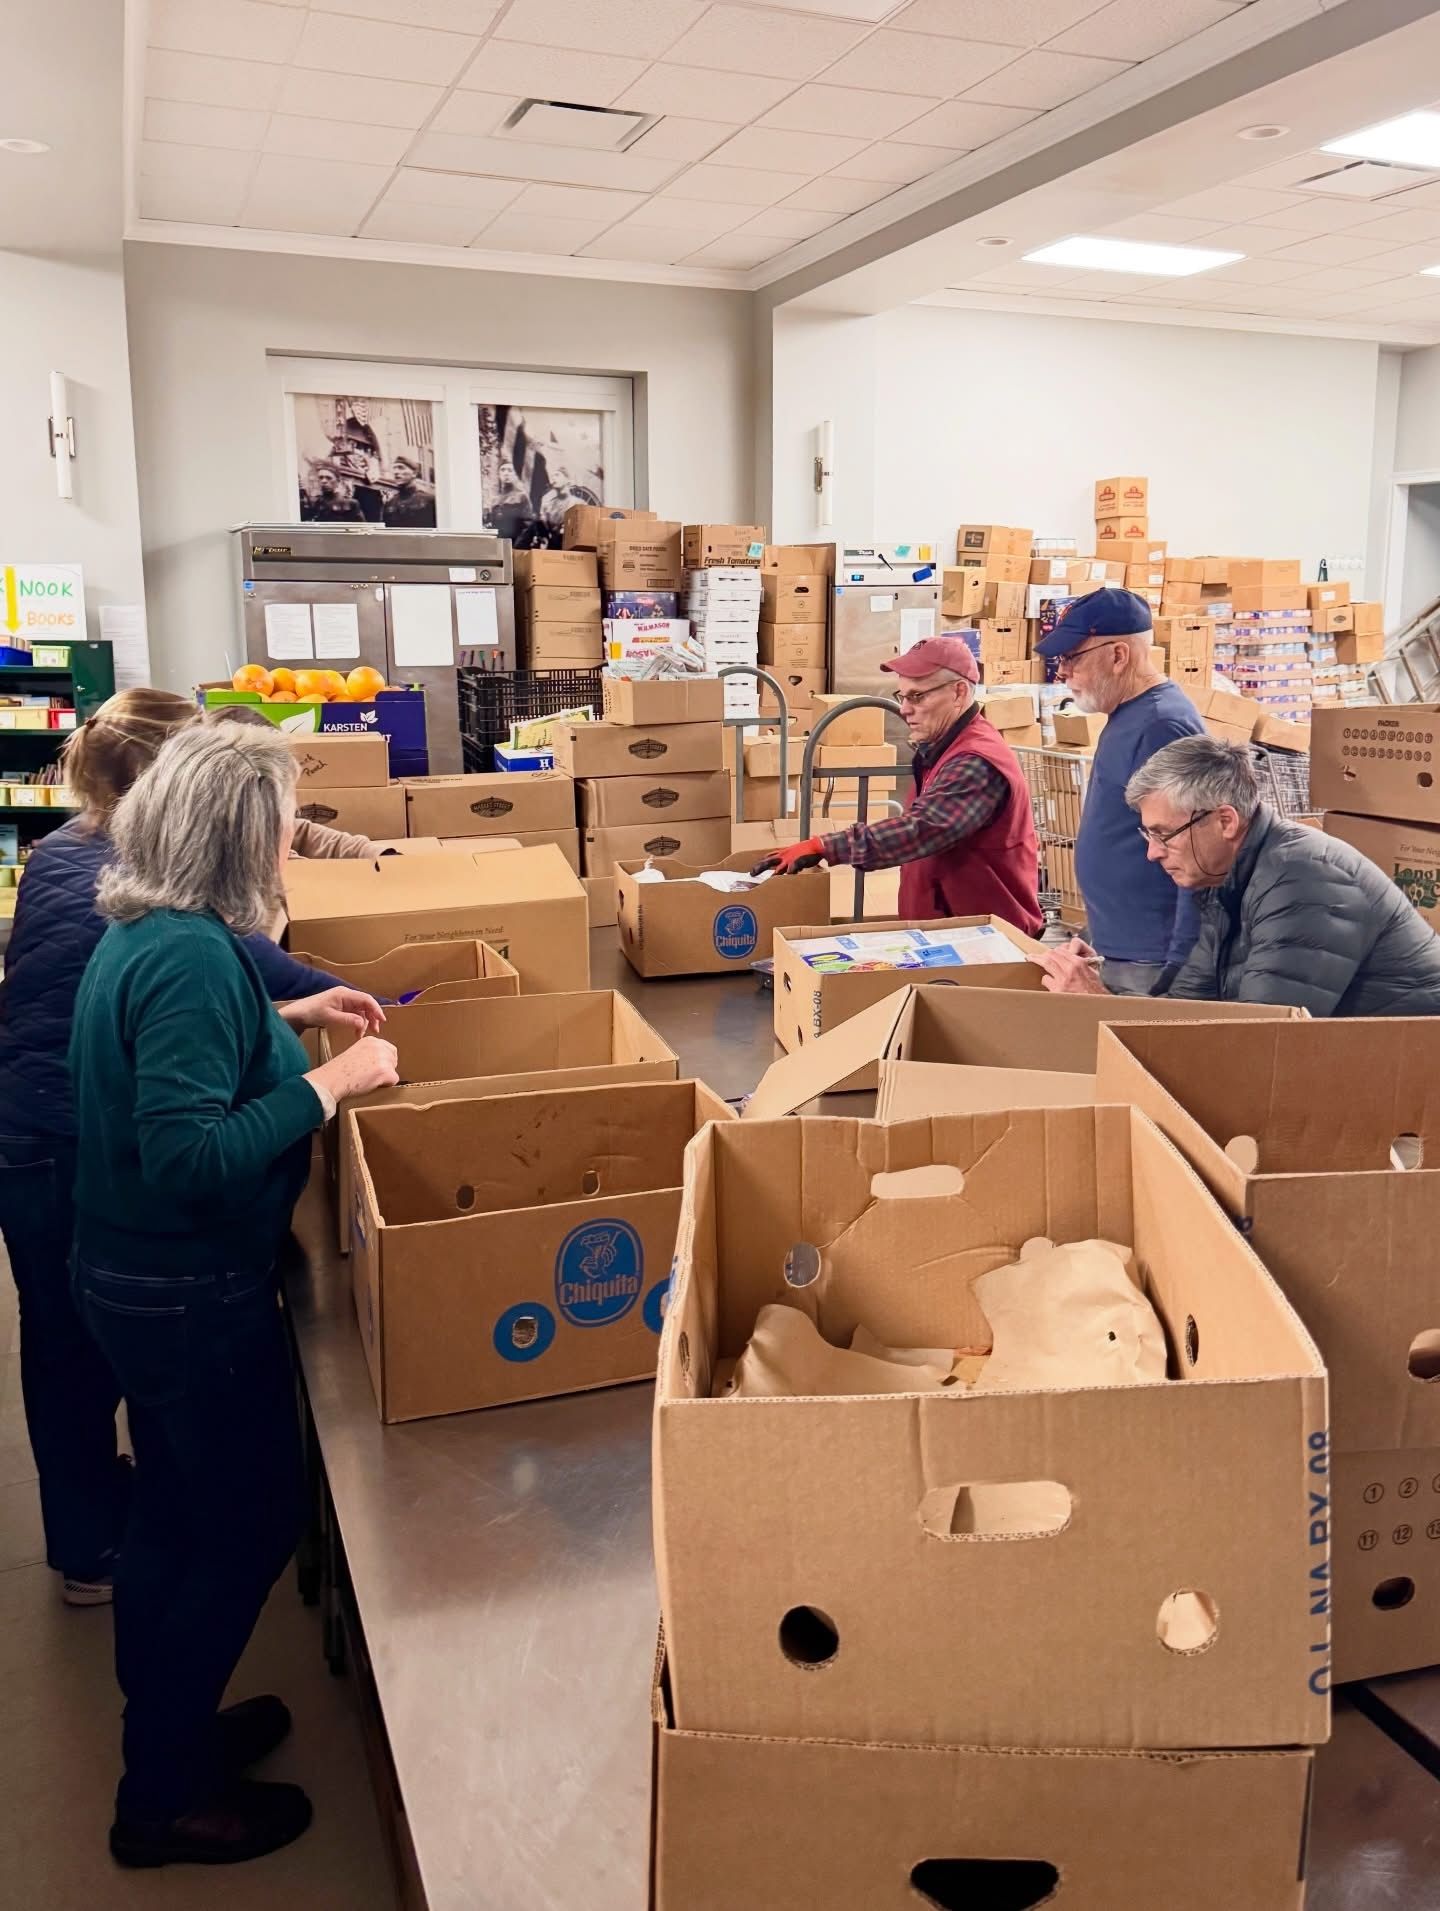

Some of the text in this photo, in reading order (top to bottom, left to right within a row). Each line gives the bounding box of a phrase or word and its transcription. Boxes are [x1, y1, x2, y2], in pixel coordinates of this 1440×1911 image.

[704, 557, 761, 565] Fresh Tomatoes
[20, 579, 73, 597] NOOK
[27, 612, 75, 626] BOOKS
[323, 723, 368, 732] KARSTEN
[715, 934, 755, 948] Chiquita
[560, 1274, 638, 1305] Chiquita
